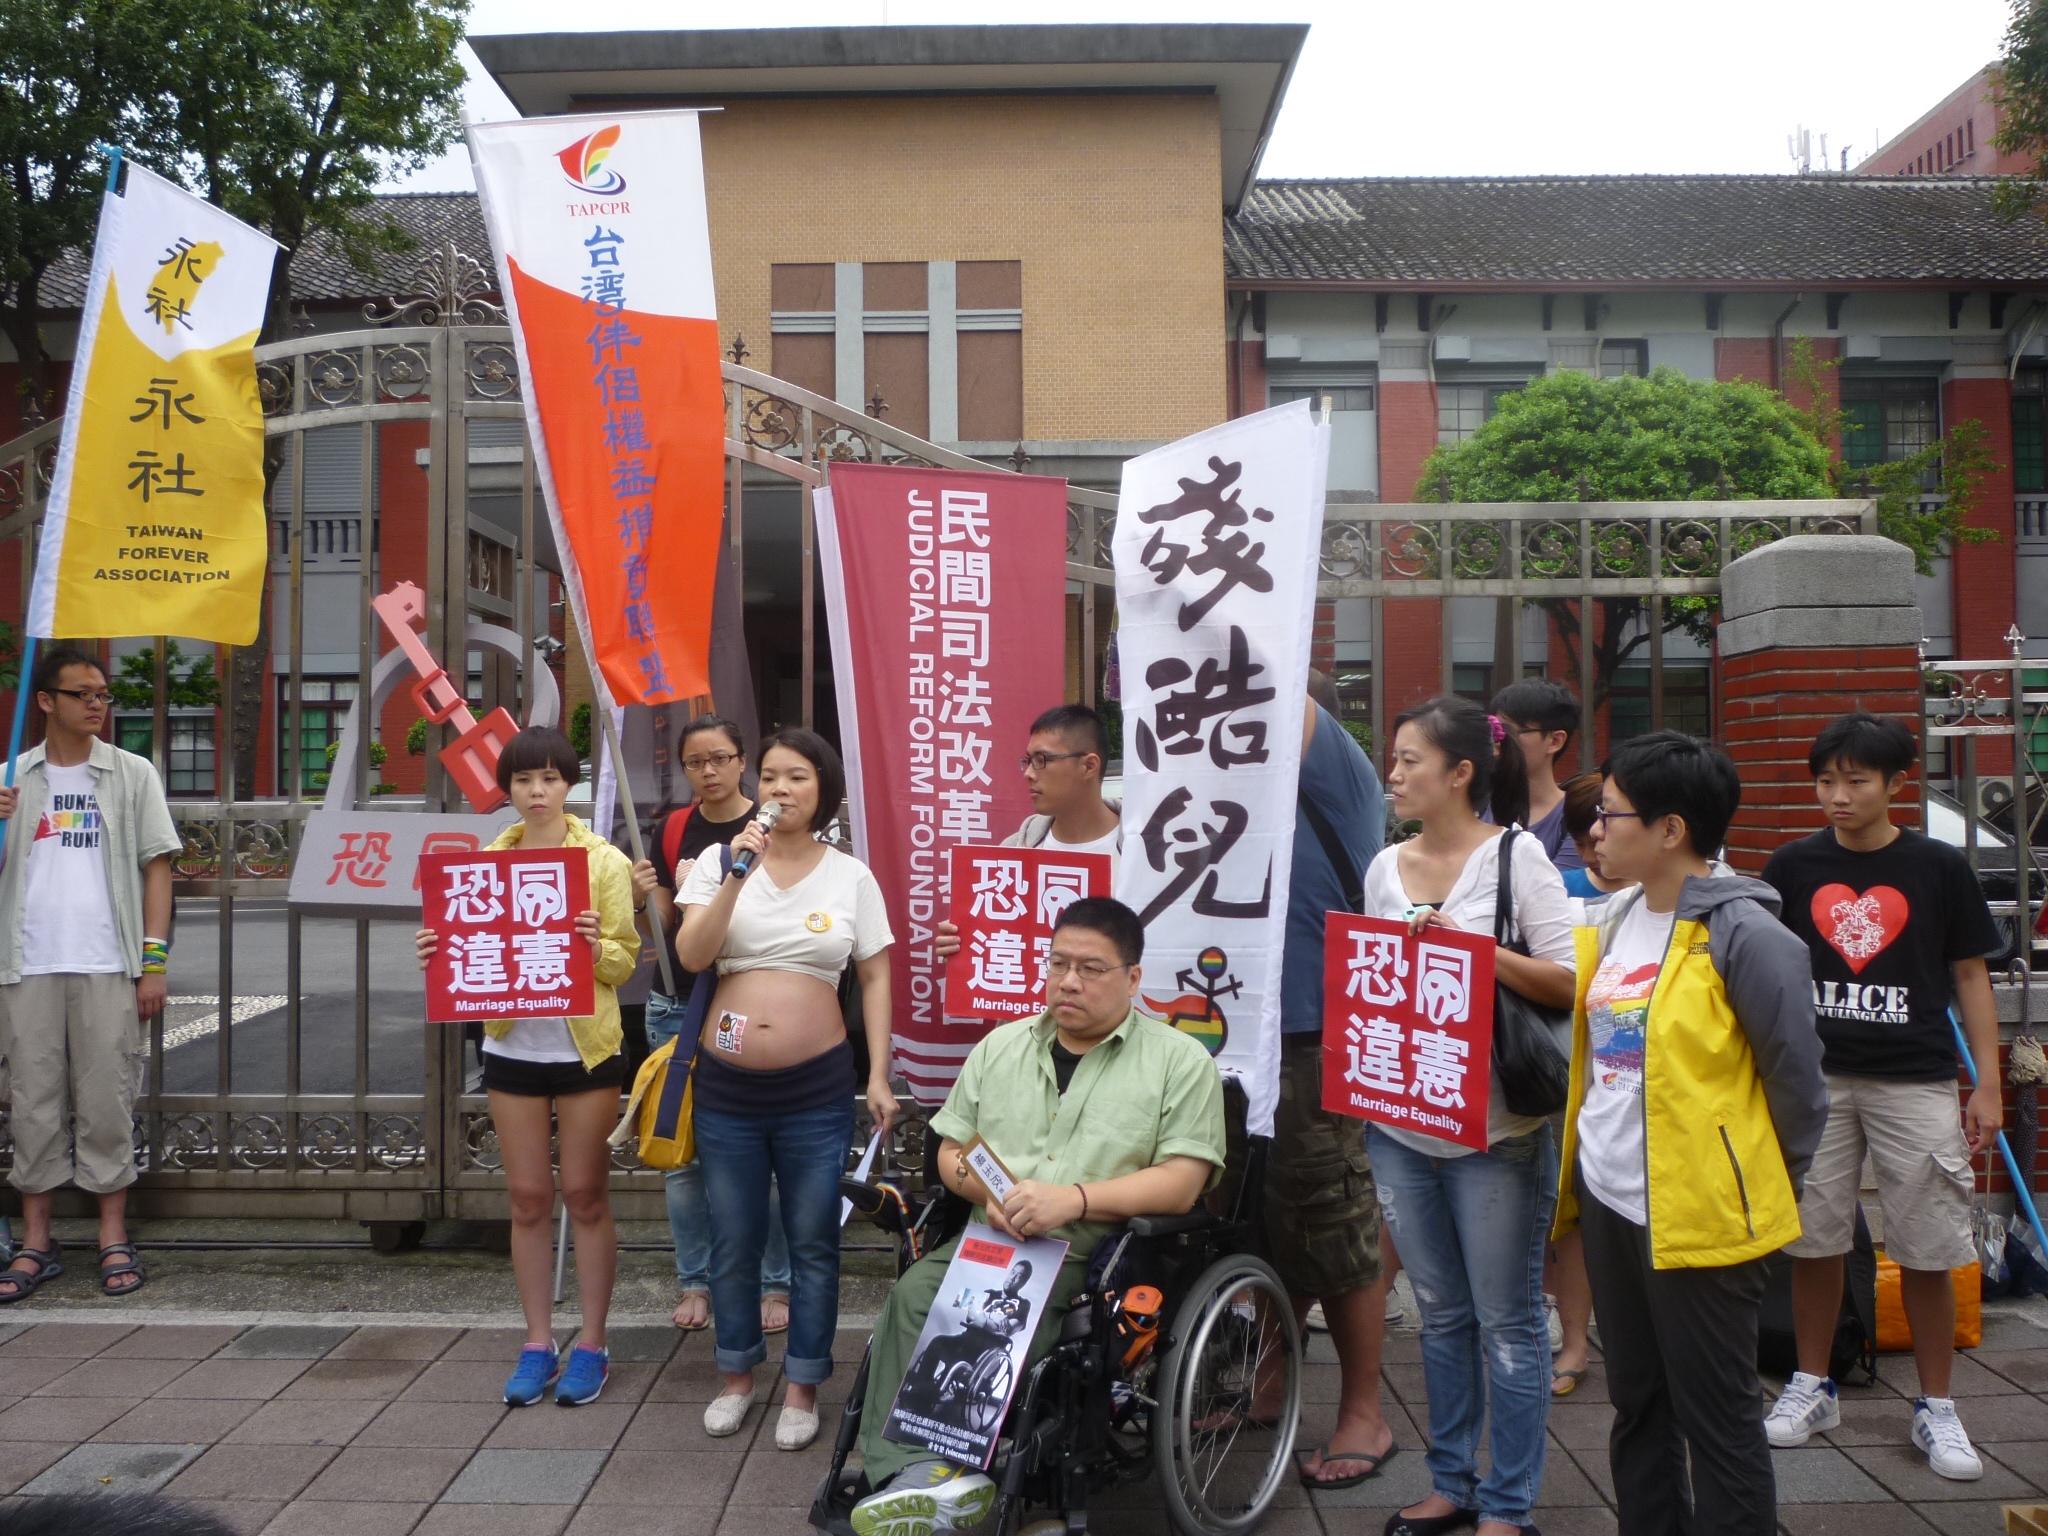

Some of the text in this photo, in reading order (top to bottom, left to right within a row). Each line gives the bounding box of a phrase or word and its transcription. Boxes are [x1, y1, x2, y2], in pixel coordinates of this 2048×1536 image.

[566, 202, 631, 217] TAPCPR
[143, 236, 204, 332] 永社
[128, 377, 206, 503] 永社
[126, 525, 204, 540] TAIWAN
[118, 546, 210, 564] FOREVER
[93, 568, 231, 583] ASSOCIATION
[907, 490, 935, 1024] JUDICIAL REFORM FOUNDATION
[54, 794, 87, 811] RUN
[52, 811, 101, 830] SOPHY
[61, 830, 100, 849] RUN!
[443, 862, 567, 927] 恐同
[446, 930, 573, 994] 違憲
[1345, 930, 1472, 1025] 恐同
[455, 996, 571, 1012] Marriage Equality
[972, 997, 1030, 1015] Marriage
[1344, 1013, 1470, 1110] 違憲
[1350, 1092, 1463, 1136] Marriage Equality
